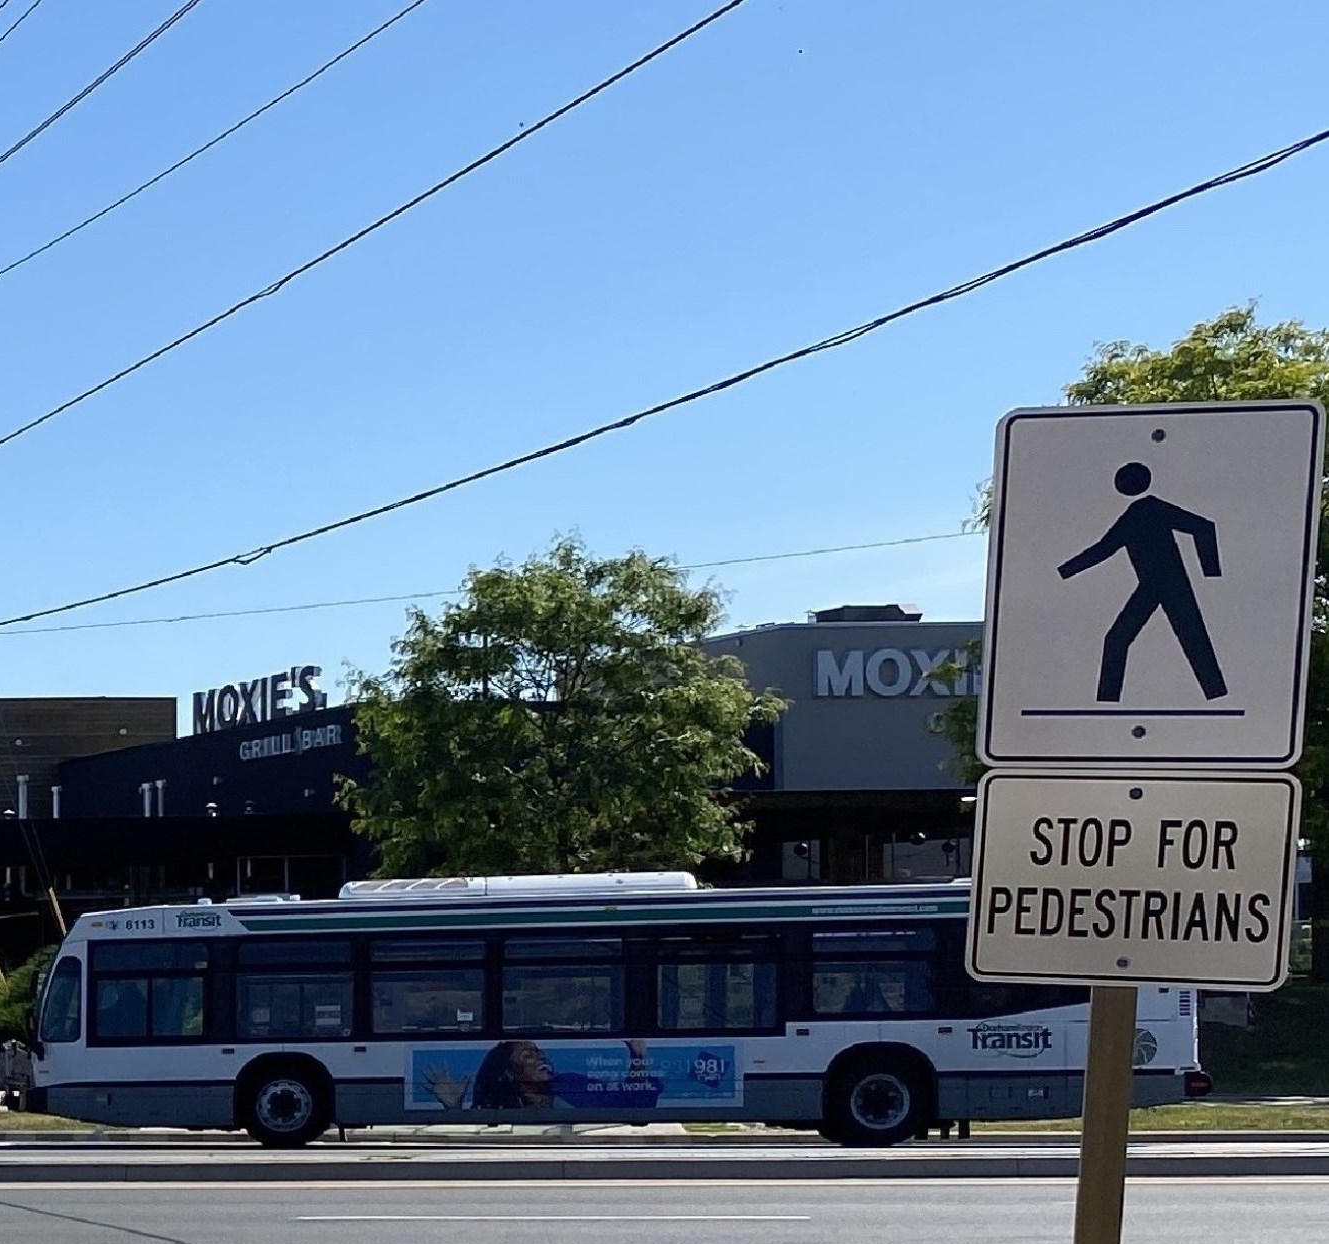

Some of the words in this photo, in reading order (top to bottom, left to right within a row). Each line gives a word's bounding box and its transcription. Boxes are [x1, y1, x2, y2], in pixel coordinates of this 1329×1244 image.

[817, 649, 982, 697] MOXI
[1030, 817, 1132, 867] STOP
[1158, 819, 1238, 870] FOR
[175, 913, 222, 928] Transit
[987, 886, 1270, 943] PEDESTRIANS
[967, 1027, 1052, 1049] Transit
